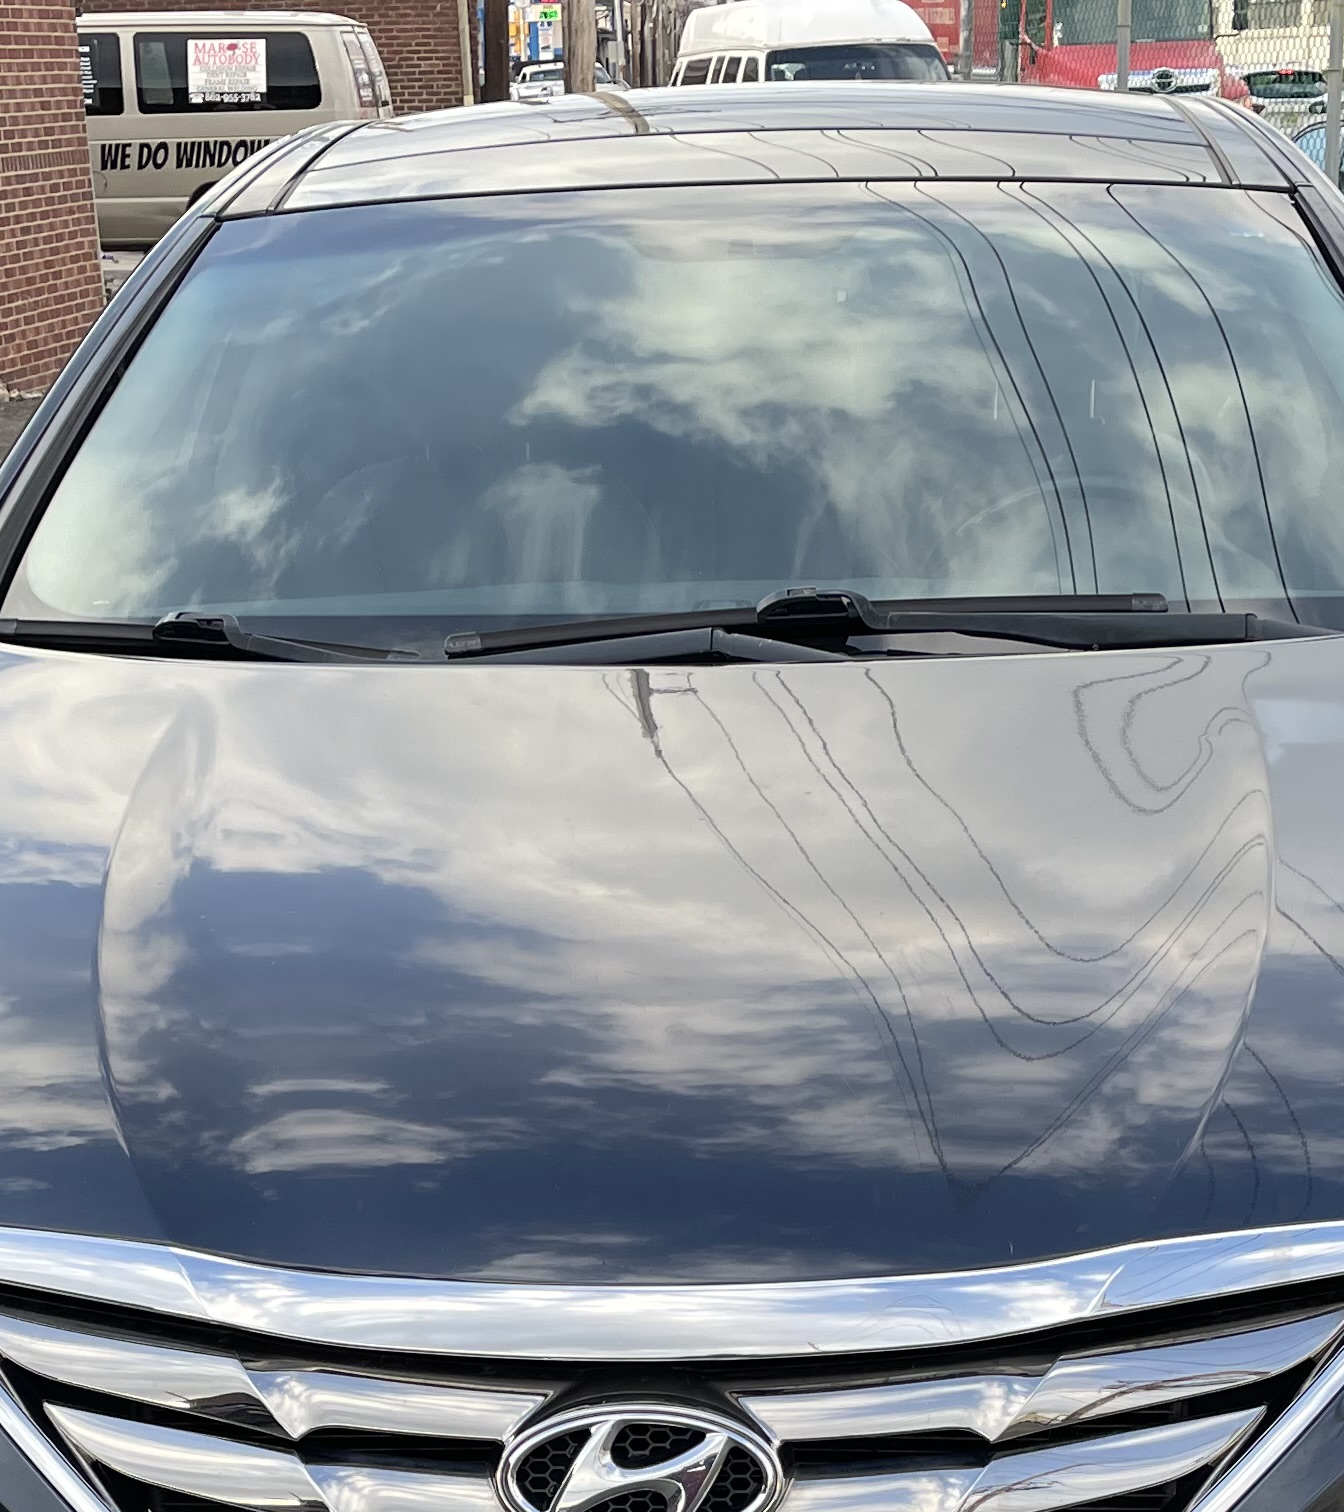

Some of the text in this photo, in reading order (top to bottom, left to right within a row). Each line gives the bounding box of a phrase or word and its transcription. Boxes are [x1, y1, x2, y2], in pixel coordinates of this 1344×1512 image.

[193, 53, 260, 65] AUTOBODY
[100, 143, 132, 171] WE
[137, 141, 169, 170] DO
